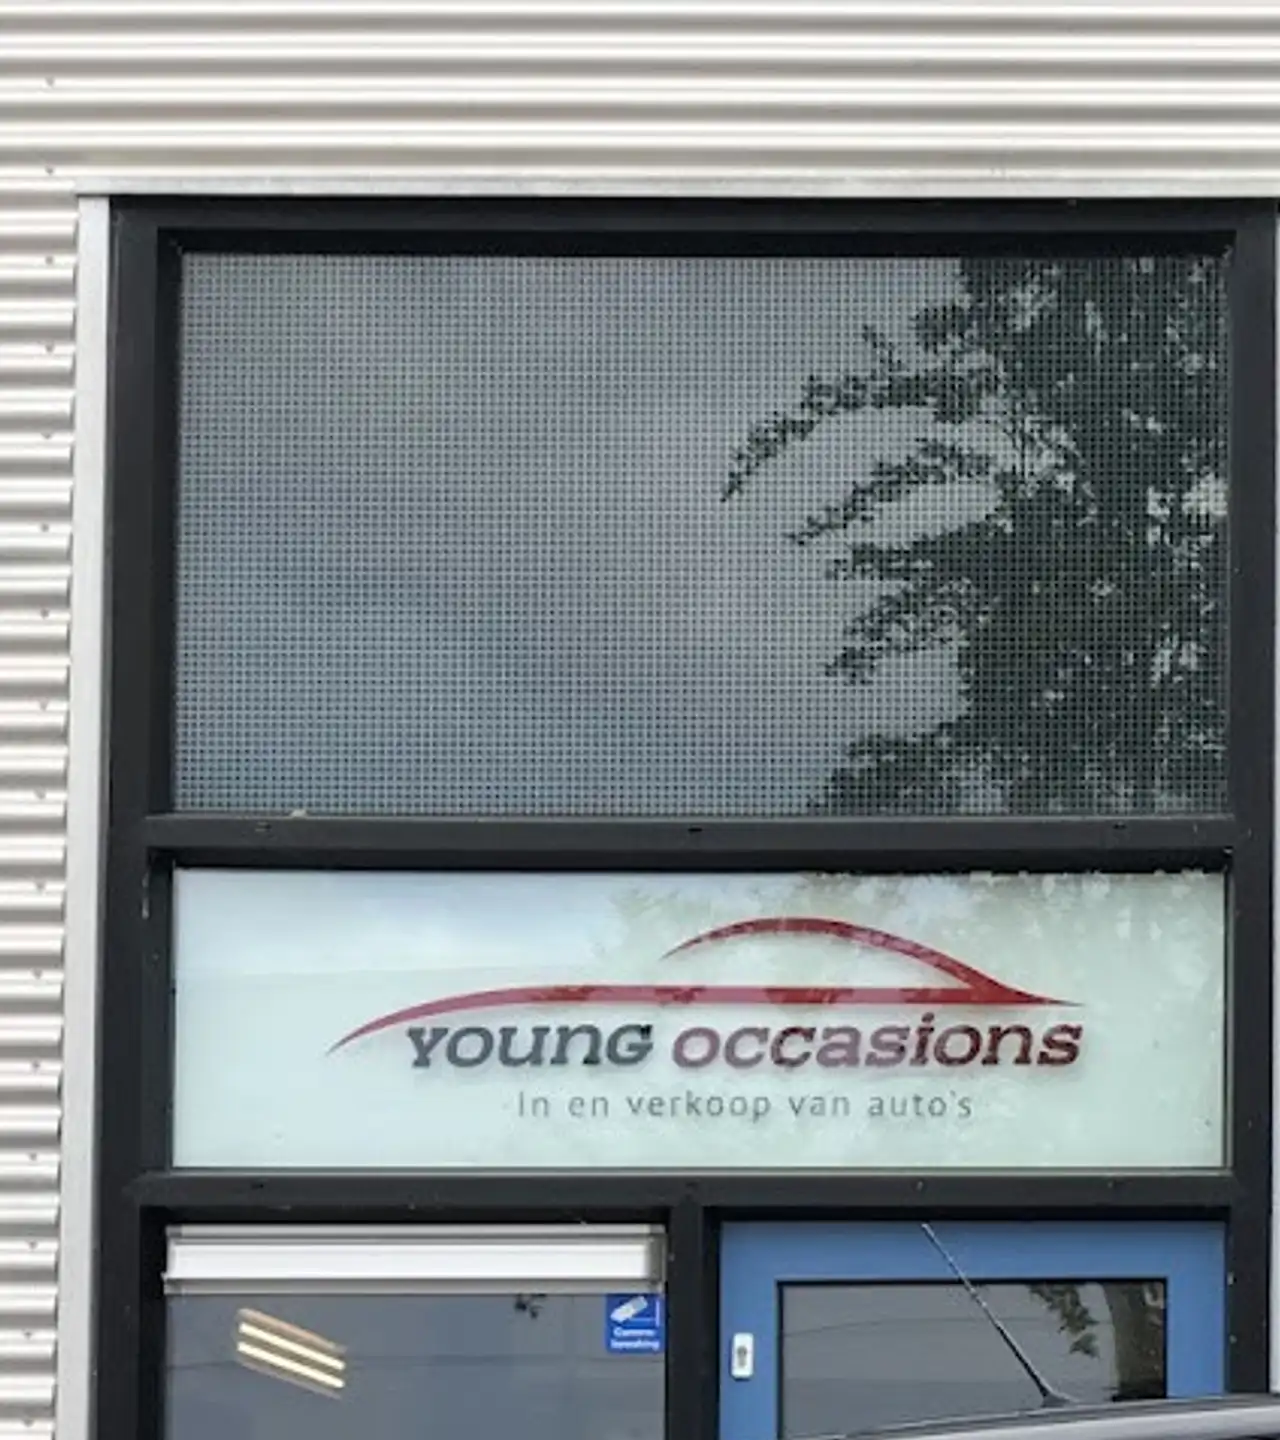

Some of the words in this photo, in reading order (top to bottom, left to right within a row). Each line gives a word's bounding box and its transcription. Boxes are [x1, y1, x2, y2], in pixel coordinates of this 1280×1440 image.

[671, 1012, 1083, 1069] occasions
[517, 1092, 550, 1118] In
[567, 1095, 609, 1118] en
[626, 1089, 772, 1123] verkoop
[788, 1095, 851, 1118] van
[867, 1090, 973, 1119] auto's
